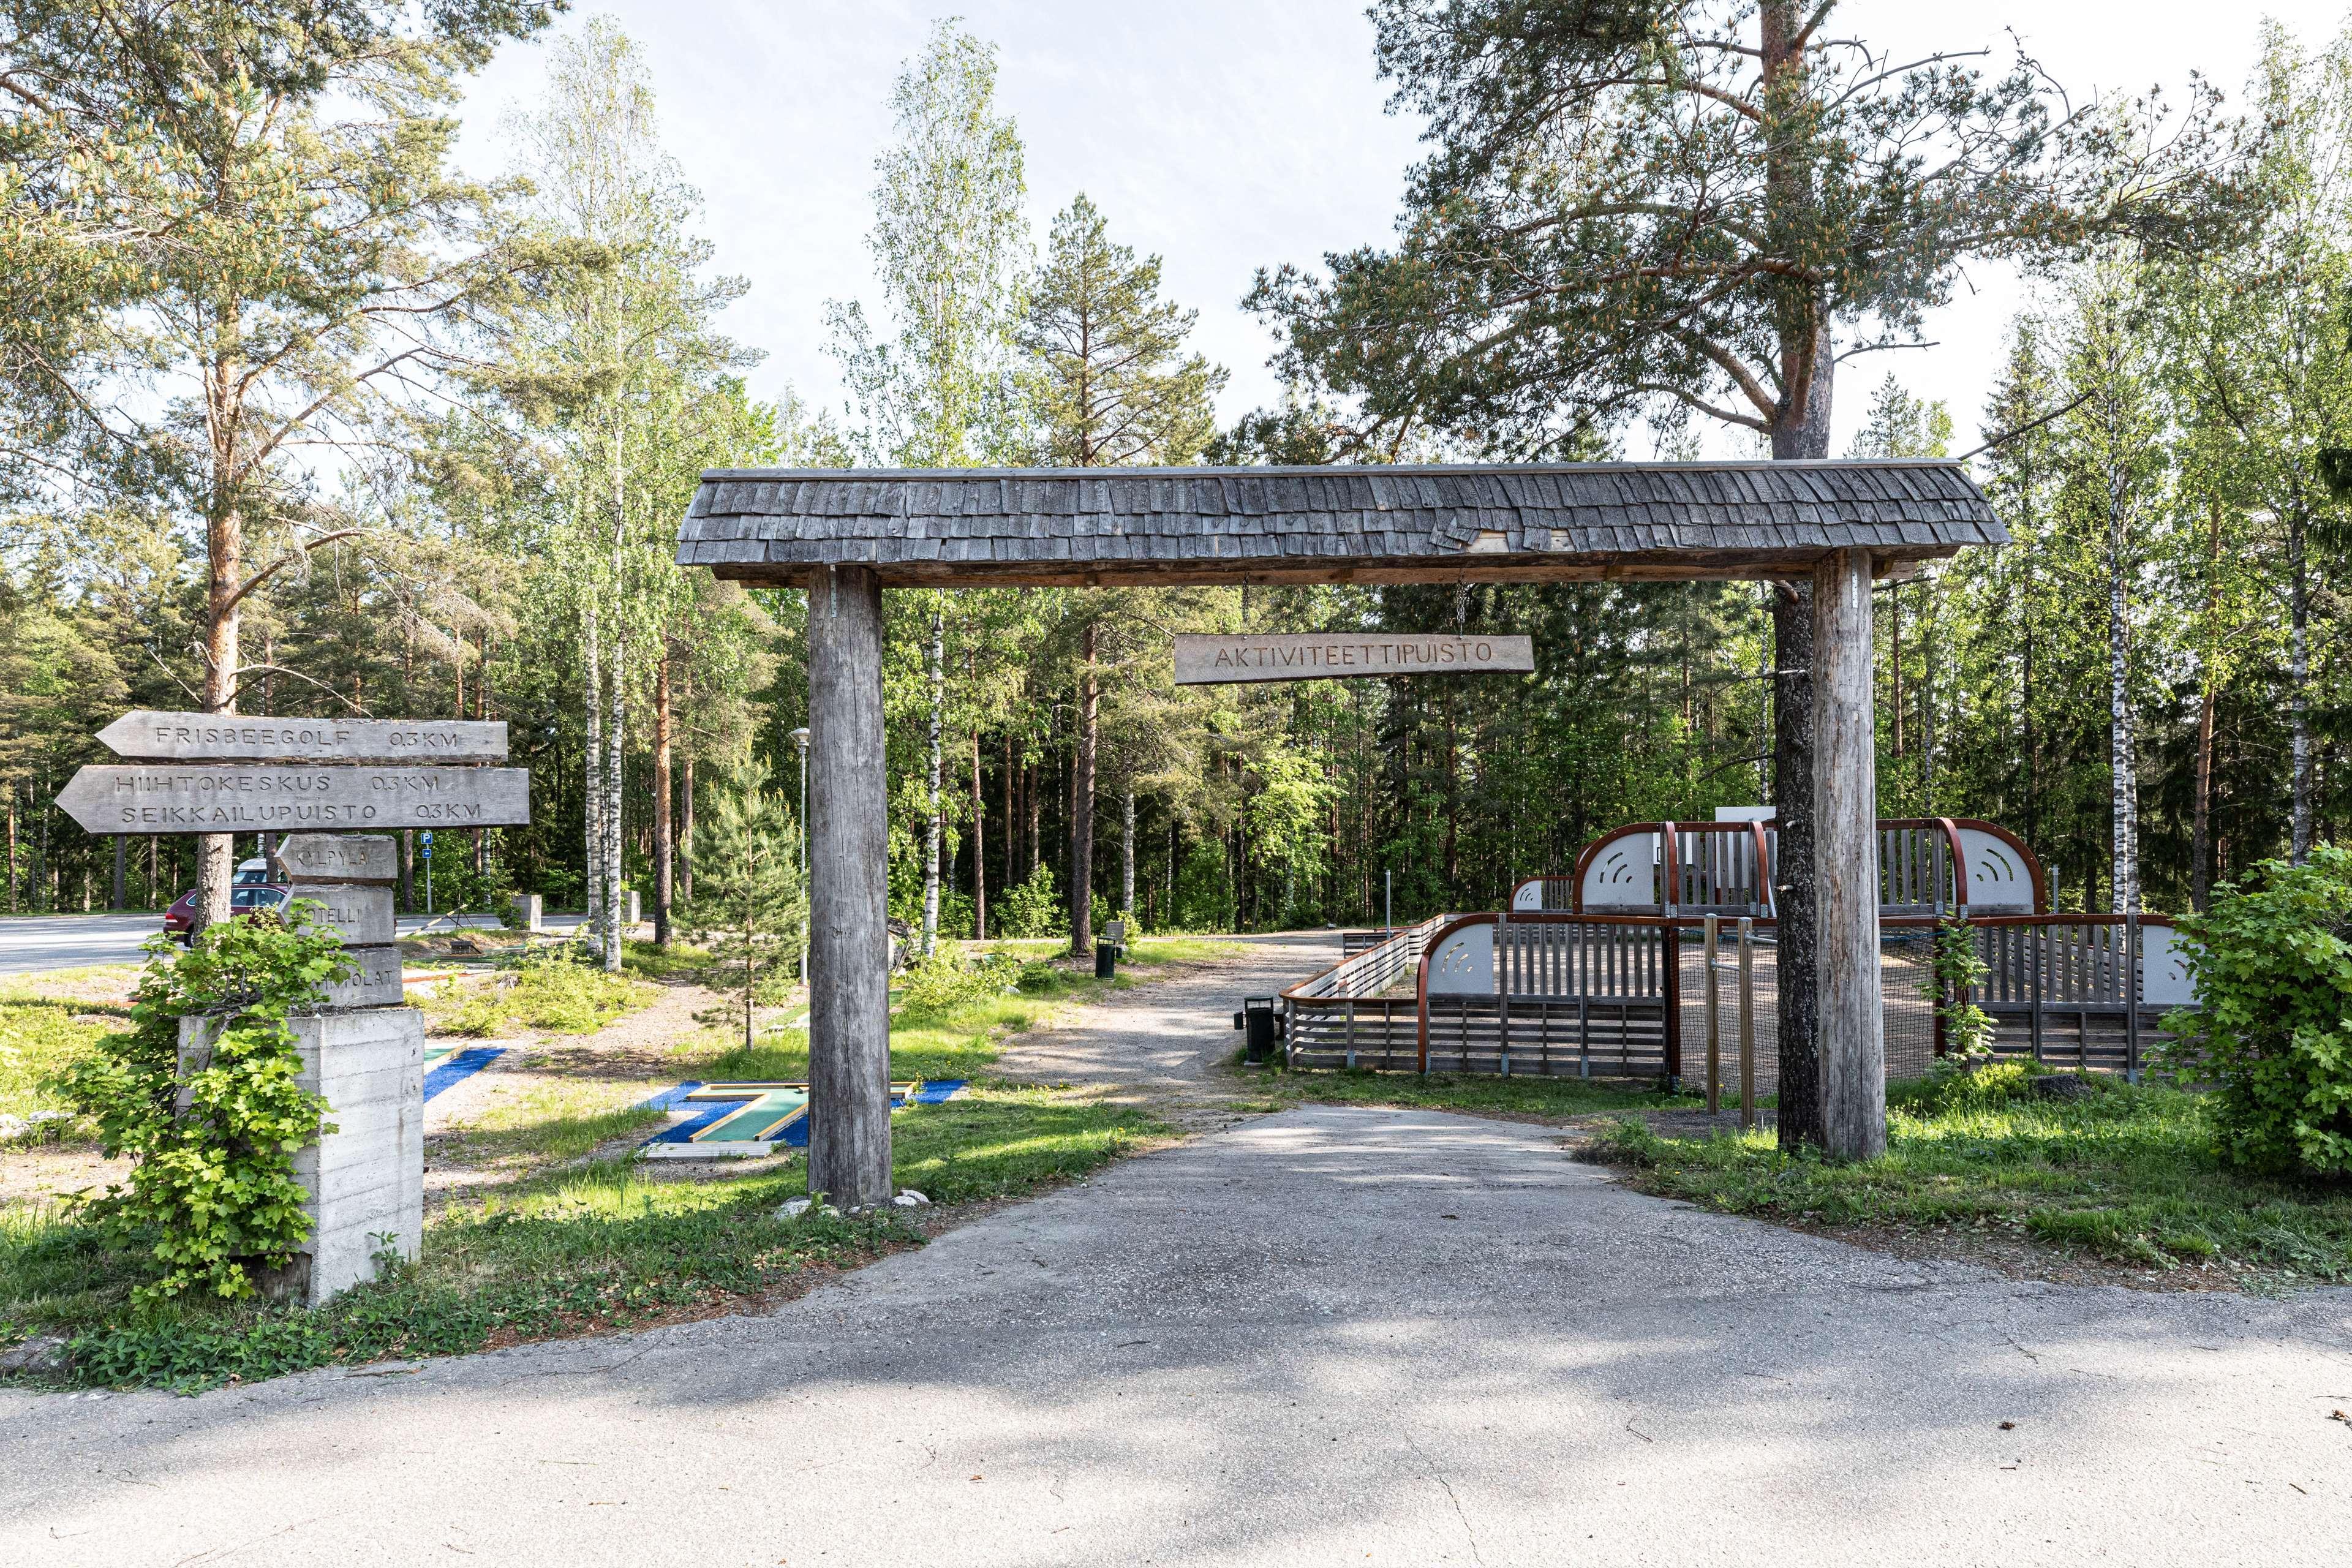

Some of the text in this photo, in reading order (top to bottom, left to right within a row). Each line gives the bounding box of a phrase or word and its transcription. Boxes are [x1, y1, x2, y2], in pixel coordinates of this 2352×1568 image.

[1215, 643, 1493, 667] AKTIVITEETTIPUISTO
[156, 727, 350, 745] FRISBEEGOLF
[115, 775, 331, 793] HIIHTOKESKUS
[122, 805, 377, 823] SEIKKAILUPUISTO
[423, 834, 431, 843] P
[295, 907, 360, 923] OTELLI
